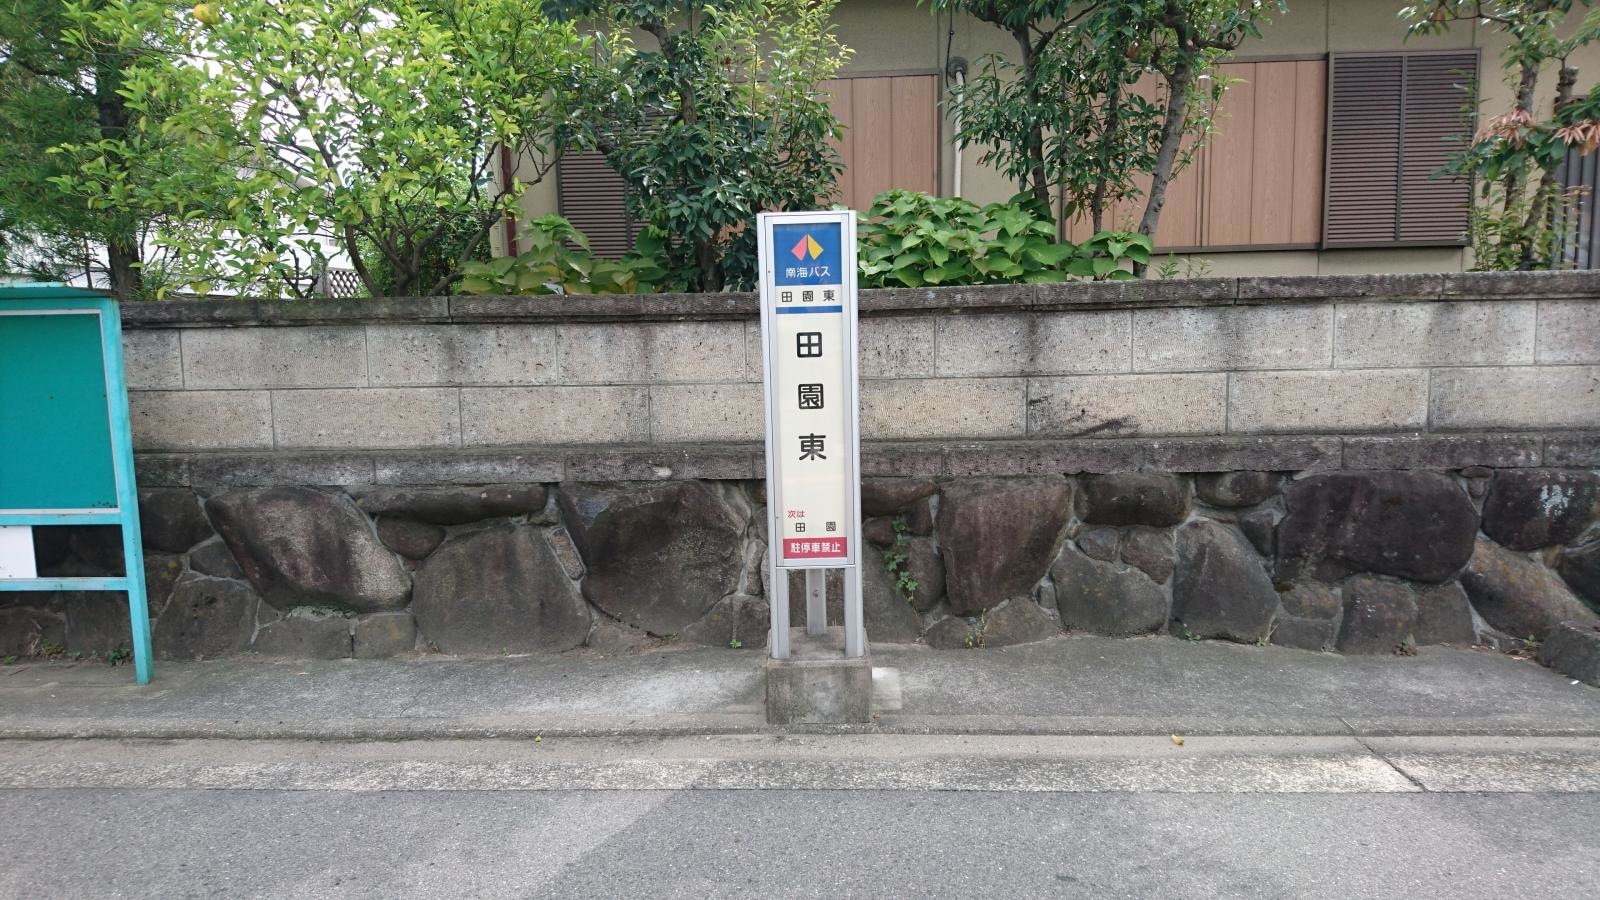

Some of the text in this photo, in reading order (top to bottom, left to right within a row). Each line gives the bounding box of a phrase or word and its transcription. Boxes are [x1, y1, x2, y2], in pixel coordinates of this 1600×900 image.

[785, 266, 831, 278] 南海バス
[782, 290, 835, 302] 田園東
[796, 331, 827, 461] 田園東
[787, 510, 805, 518] 次は
[795, 521, 836, 532] 田園
[790, 542, 840, 553] 駐停車禁止
